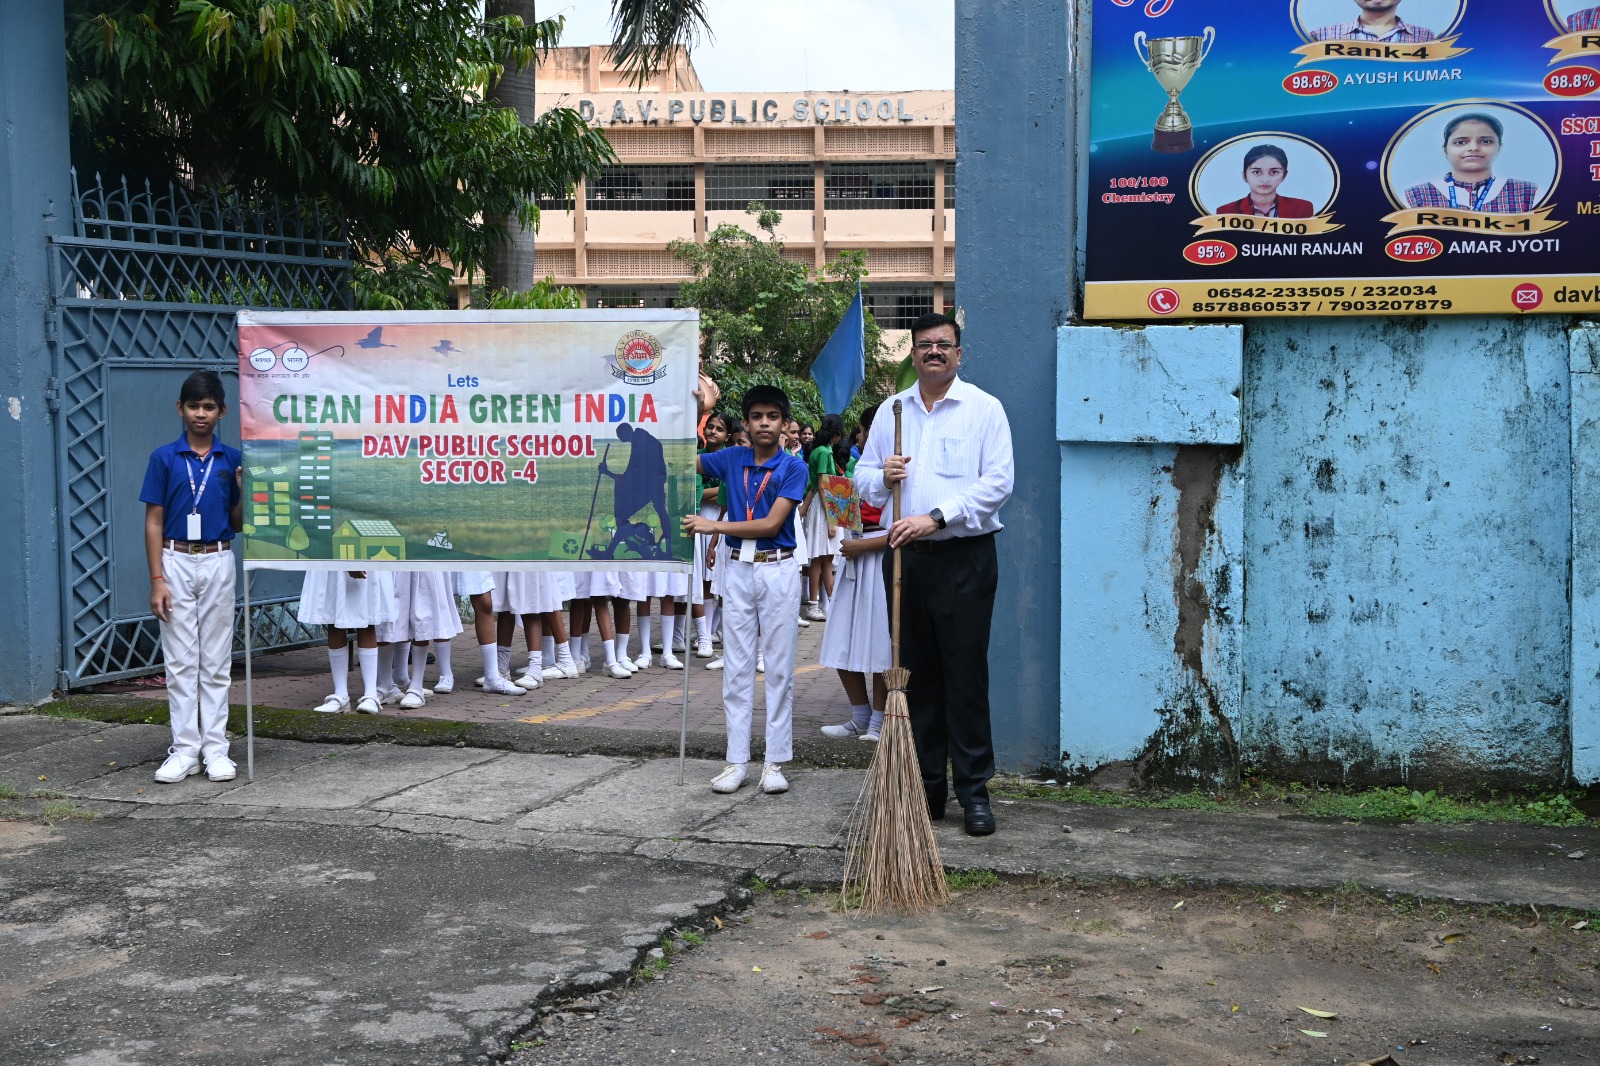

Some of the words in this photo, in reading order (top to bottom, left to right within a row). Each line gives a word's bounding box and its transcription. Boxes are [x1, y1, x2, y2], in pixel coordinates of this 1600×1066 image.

[1324, 43, 1429, 60] Rank-4
[1292, 75, 1334, 89] 98.6%
[1344, 71, 1398, 86] AYUSH
[1403, 69, 1463, 82] KUMAR
[1550, 74, 1596, 89] 98.8%
[668, 99, 778, 122] PUBLIC
[793, 98, 914, 121] SCHOOL
[1110, 176, 1169, 188] 100/100
[1101, 192, 1176, 204] Chemistry
[1416, 212, 1531, 231] Rank-1
[1197, 245, 1226, 259] 95%
[1241, 243, 1297, 257] SUHANI
[1301, 242, 1363, 256] RANJAN
[1394, 242, 1437, 255] 97.6%
[1448, 240, 1502, 254] AMAR
[1507, 239, 1560, 253] JYOTI
[1207, 287, 1345, 298] 06542-233505
[1362, 285, 1438, 297] 232034
[1192, 301, 1311, 312] 8578860537
[1328, 300, 1453, 312] 7903207879
[447, 373, 479, 388] Lets
[272, 394, 361, 424] CLEAN
[374, 394, 459, 424] INDIA
[469, 393, 561, 424] GREEN
[574, 393, 659, 423] INDIA
[363, 434, 411, 457] DAV
[419, 434, 499, 457] PUBLIC
[506, 434, 595, 457] SCHOOL
[422, 460, 506, 483] SECTOR
[513, 460, 538, 482] -4
